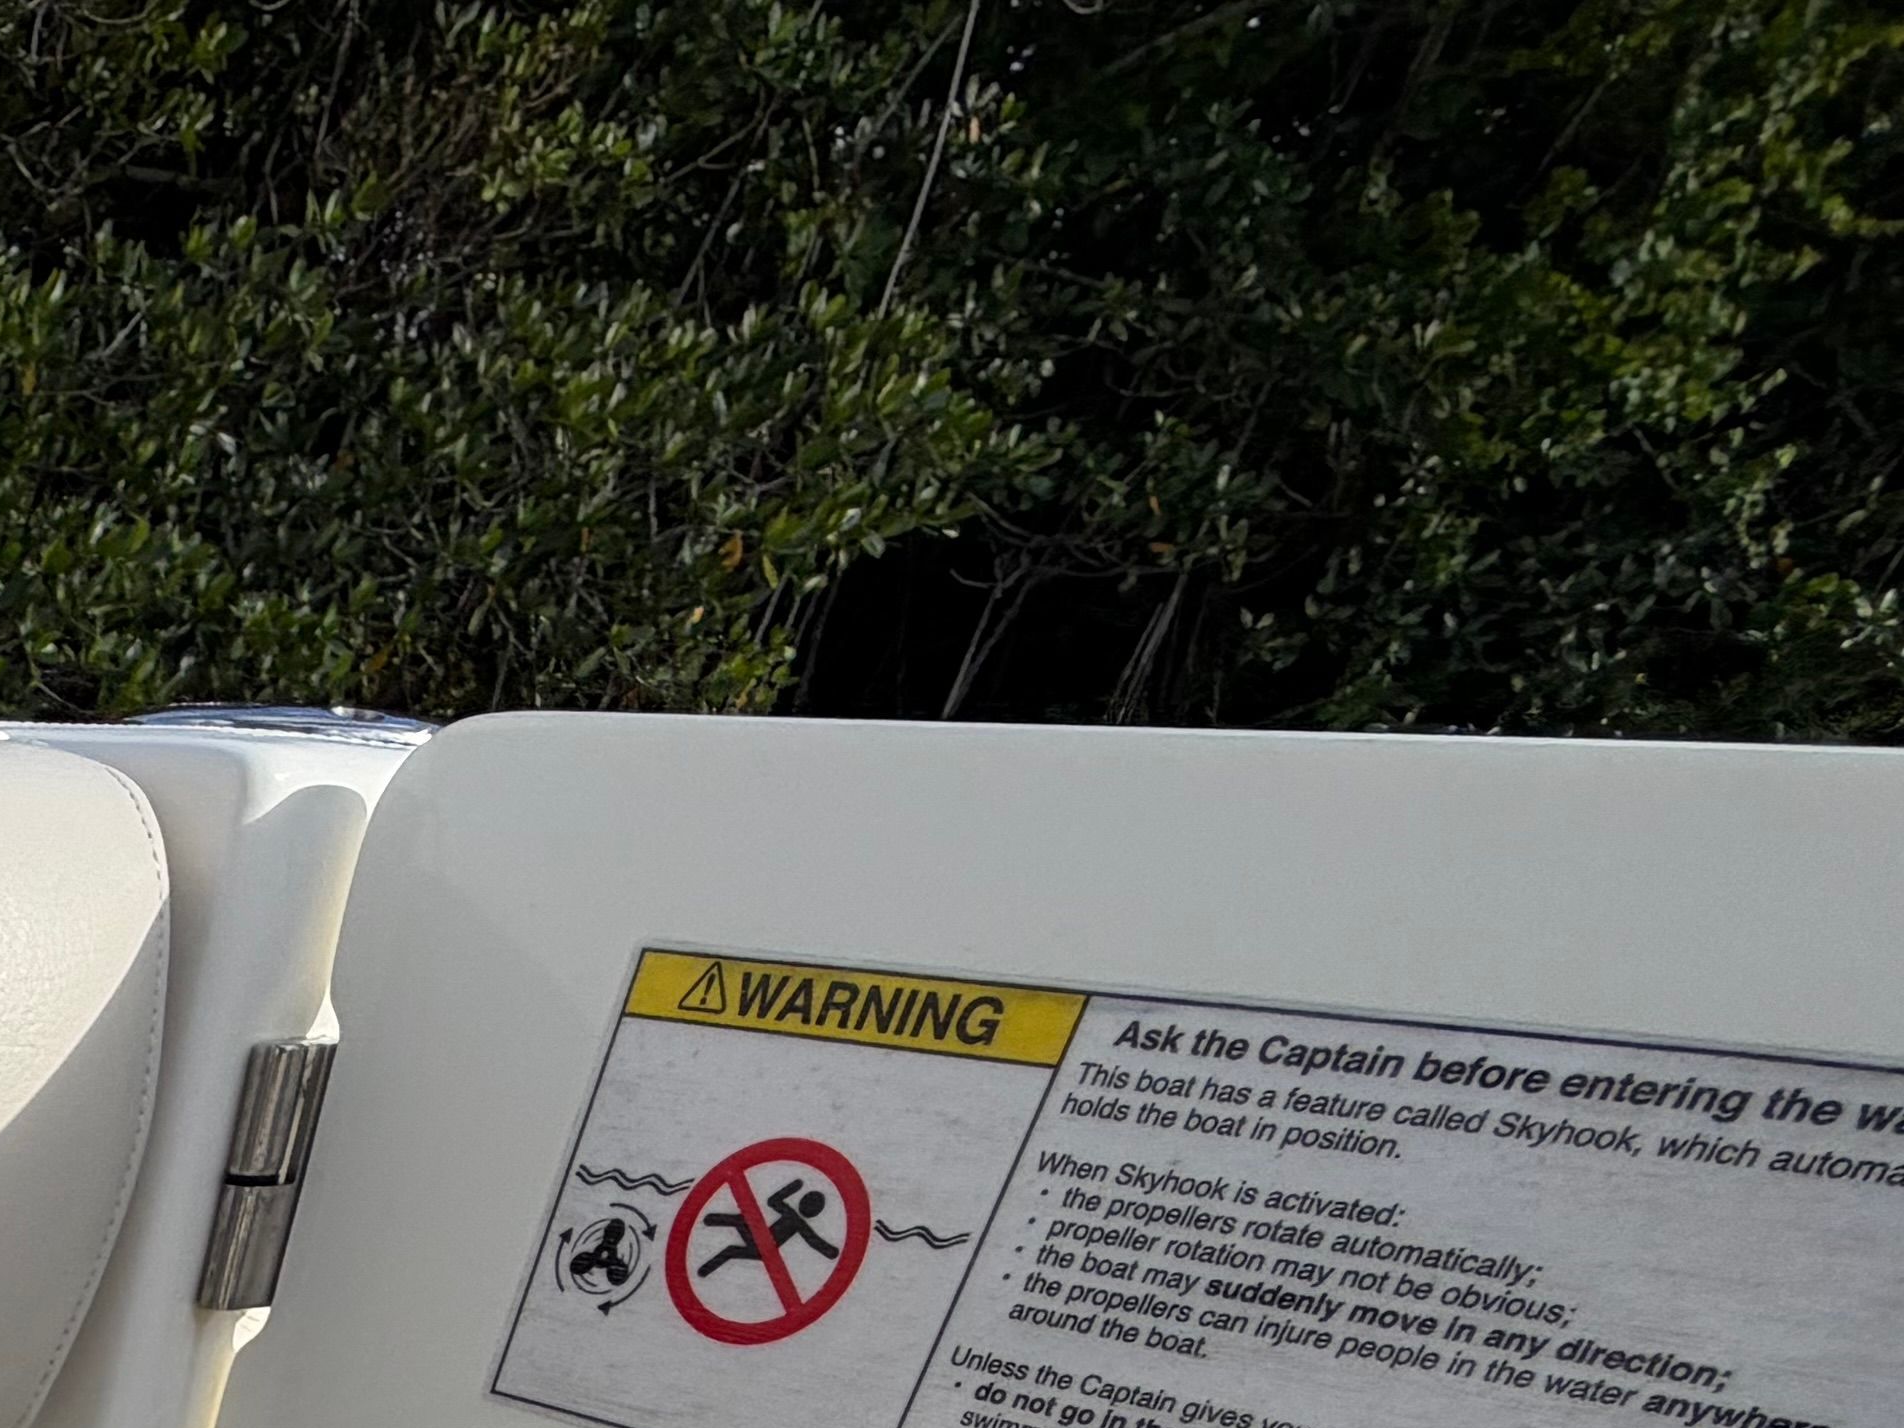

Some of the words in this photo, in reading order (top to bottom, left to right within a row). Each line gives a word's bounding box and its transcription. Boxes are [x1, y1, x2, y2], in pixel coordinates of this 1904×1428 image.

[737, 971, 1005, 1046] WARNING
[1079, 1061, 1130, 1089] This
[1134, 1069, 1196, 1098] boat
[1199, 1077, 1253, 1105] has
[1257, 1090, 1277, 1109] a
[1283, 1087, 1387, 1122] feature
[1392, 1104, 1491, 1133] called
[1492, 1112, 1642, 1157] Skyhook,
[1657, 1133, 1761, 1168] which
[1112, 1021, 1185, 1054] Ask
[1191, 1029, 1250, 1061] the
[1258, 1035, 1405, 1078] Captain
[1412, 1051, 1551, 1094] before
[1559, 1073, 1754, 1123] entering
[1761, 1088, 1844, 1126] the
[1060, 1092, 1131, 1122] holds
[1136, 1102, 1178, 1128] the
[1183, 1108, 1247, 1138] boat
[1249, 1116, 1278, 1142] in
[1278, 1127, 1400, 1159] position.
[1037, 1150, 1109, 1182] When
[1115, 1162, 1230, 1201] Skyhook
[1232, 1180, 1259, 1205] is
[1264, 1191, 1406, 1227] activated:
[1045, 1220, 1161, 1252] propeller
[1164, 1240, 1266, 1272] rotation
[1271, 1259, 1336, 1287] may
[1338, 1270, 1390, 1294] not
[1393, 1273, 1434, 1300] be
[1440, 1284, 1577, 1329] obvious;
[1062, 1187, 1102, 1212] the
[1103, 1199, 1238, 1235] propellers
[1242, 1220, 1325, 1248] rotate
[1330, 1234, 1544, 1288] automatically;
[1008, 1304, 1097, 1334] around
[1099, 1318, 1140, 1343] the
[1144, 1326, 1207, 1359] boat.
[1023, 1272, 1063, 1297] the
[1064, 1285, 1194, 1323] propellers
[1198, 1310, 1249, 1333] can
[1254, 1315, 1333, 1349] injure
[1334, 1337, 1441, 1370] people
[1446, 1351, 1477, 1378] in
[1483, 1360, 1536, 1388] the
[1544, 1375, 1639, 1406] water
[1036, 1244, 1075, 1269] the
[1080, 1251, 1139, 1281] boat
[1141, 1268, 1201, 1297] may
[1204, 1279, 1346, 1322] suddenly
[1347, 1305, 1438, 1336] move
[1443, 1316, 1477, 1344] in
[1483, 1329, 1551, 1360] any
[1555, 1338, 1733, 1393] direction;
[950, 1345, 1030, 1381] Unless
[1034, 1365, 1073, 1390] the
[1080, 1374, 1177, 1413] Captain
[974, 1382, 1007, 1405] do
[1012, 1393, 1057, 1417] not
[1057, 1405, 1095, 1427] go
